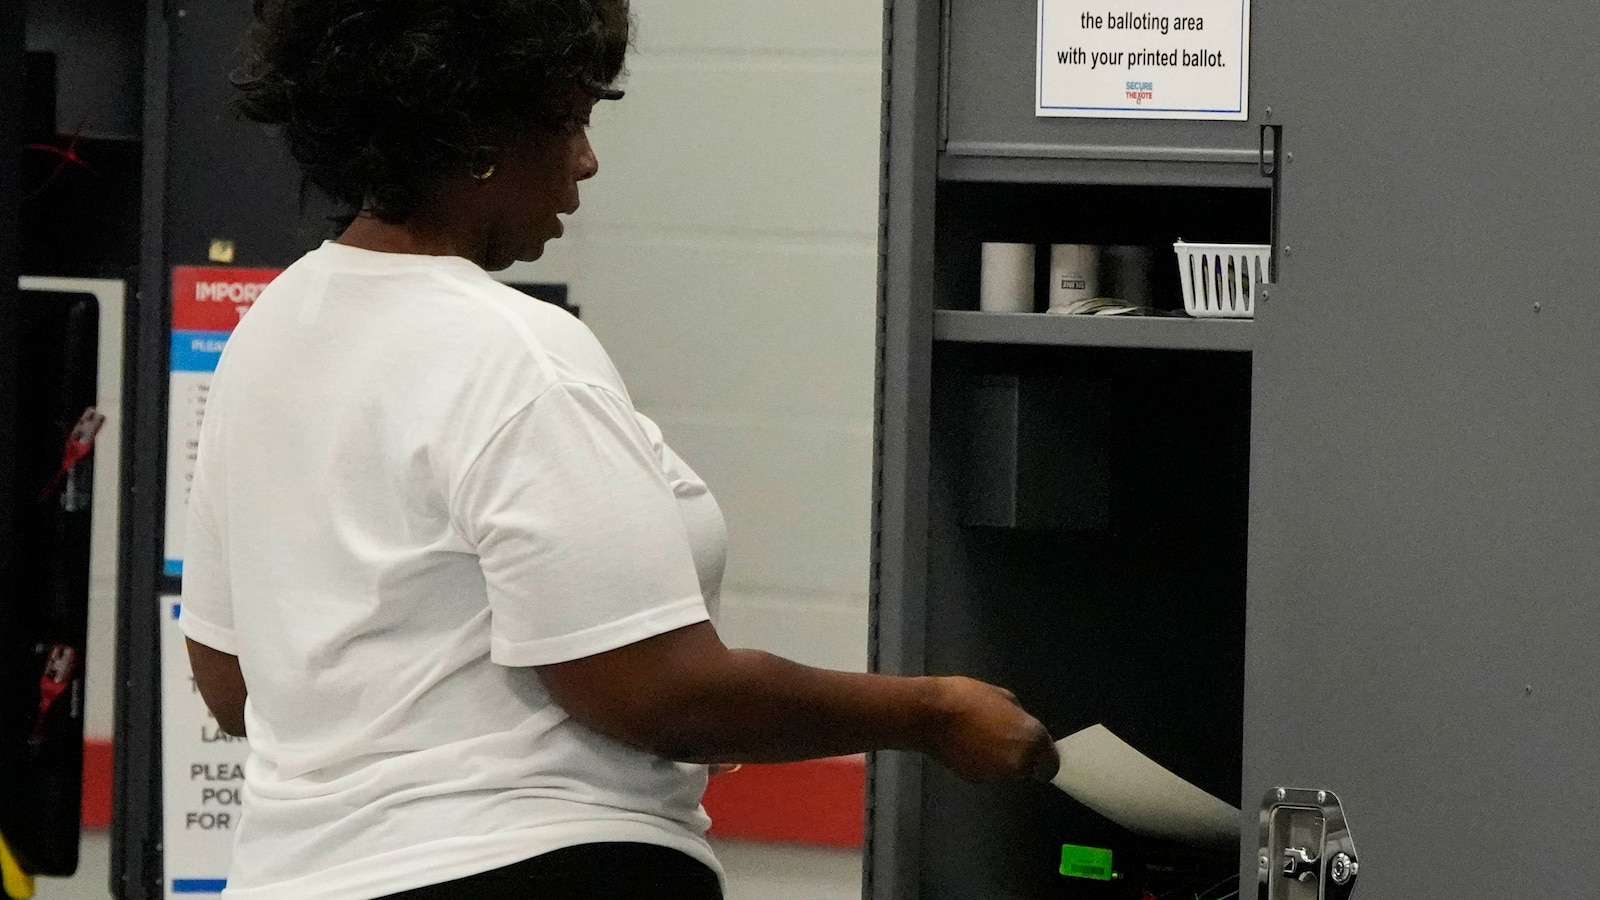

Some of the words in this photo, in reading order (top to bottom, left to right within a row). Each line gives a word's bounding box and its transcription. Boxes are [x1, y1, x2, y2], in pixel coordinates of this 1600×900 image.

[1081, 12, 1103, 29] the
[1107, 12, 1169, 35] balloting
[1173, 16, 1204, 31] area
[1057, 47, 1086, 65] with
[1091, 51, 1123, 70] your
[1128, 49, 1178, 70] printed
[1182, 50, 1226, 67] ballot.
[1126, 81, 1153, 91] SECURE
[1126, 91, 1137, 99] THE
[185, 812, 231, 830] FOR
